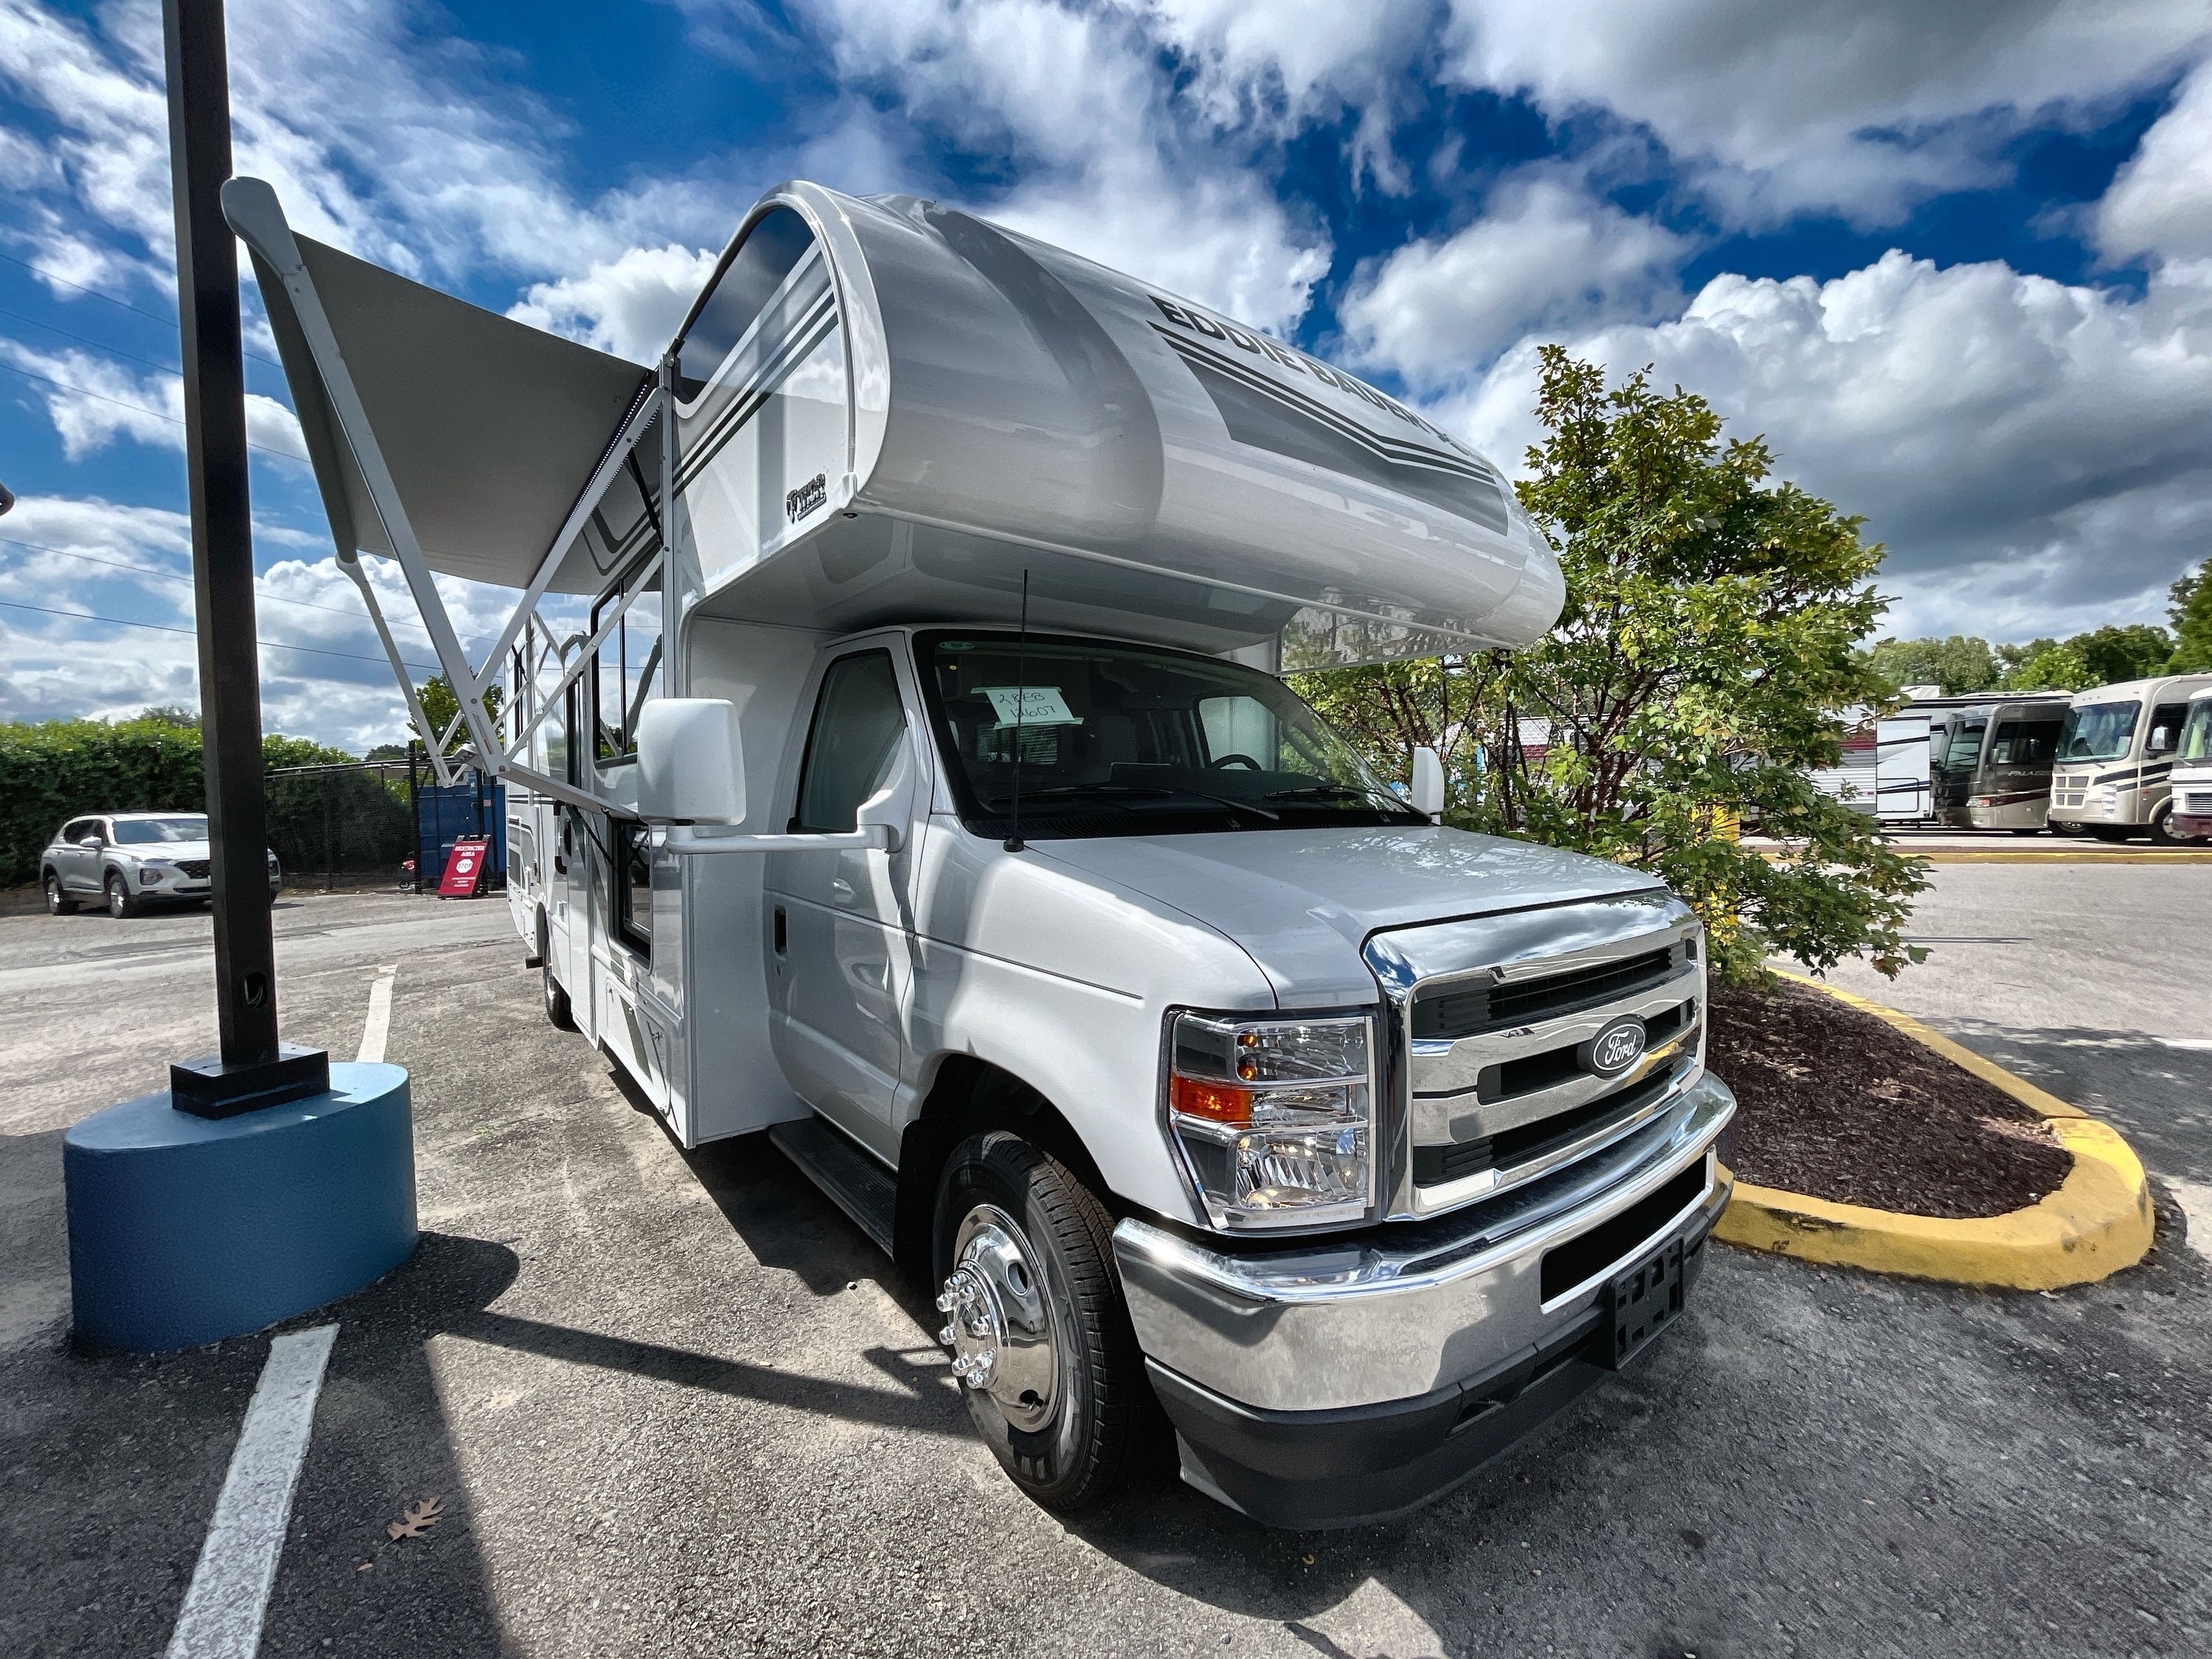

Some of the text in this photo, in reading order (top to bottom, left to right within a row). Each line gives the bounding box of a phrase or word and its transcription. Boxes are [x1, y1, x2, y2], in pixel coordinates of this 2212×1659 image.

[1147, 293, 1432, 434] EDDIE BAUER
[998, 692, 1046, 706] 28EB
[1604, 1030, 1637, 1065] Ford
